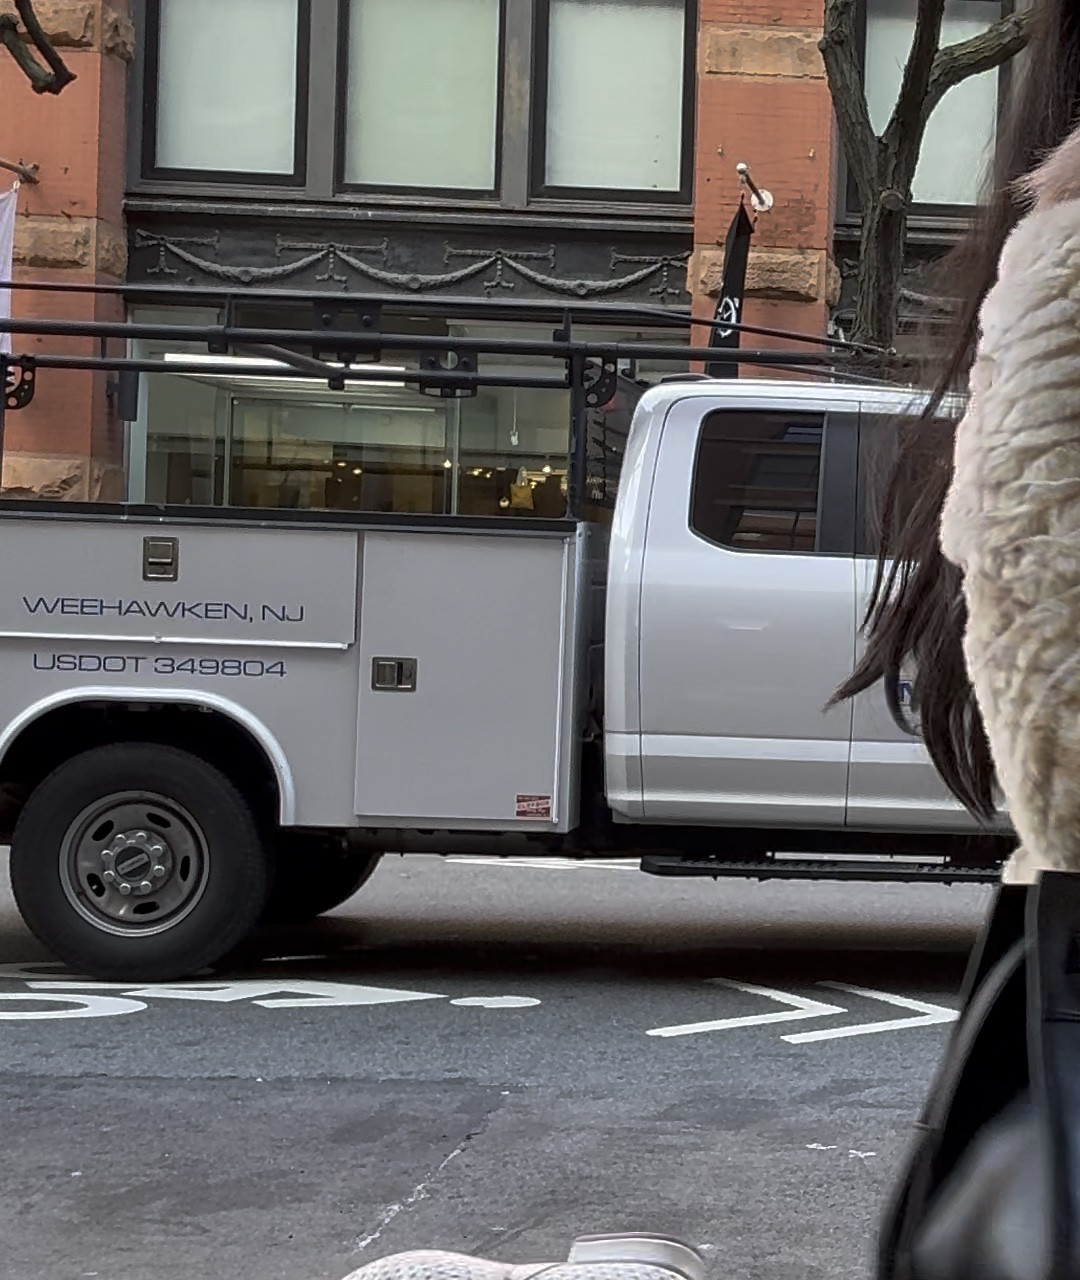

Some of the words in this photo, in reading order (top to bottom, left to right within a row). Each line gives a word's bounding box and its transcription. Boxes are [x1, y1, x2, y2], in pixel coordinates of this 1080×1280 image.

[22, 596, 254, 623] WEEHAWKEN,
[262, 604, 305, 622] NJ
[33, 654, 148, 673] USDOT
[154, 658, 287, 678] 349804
